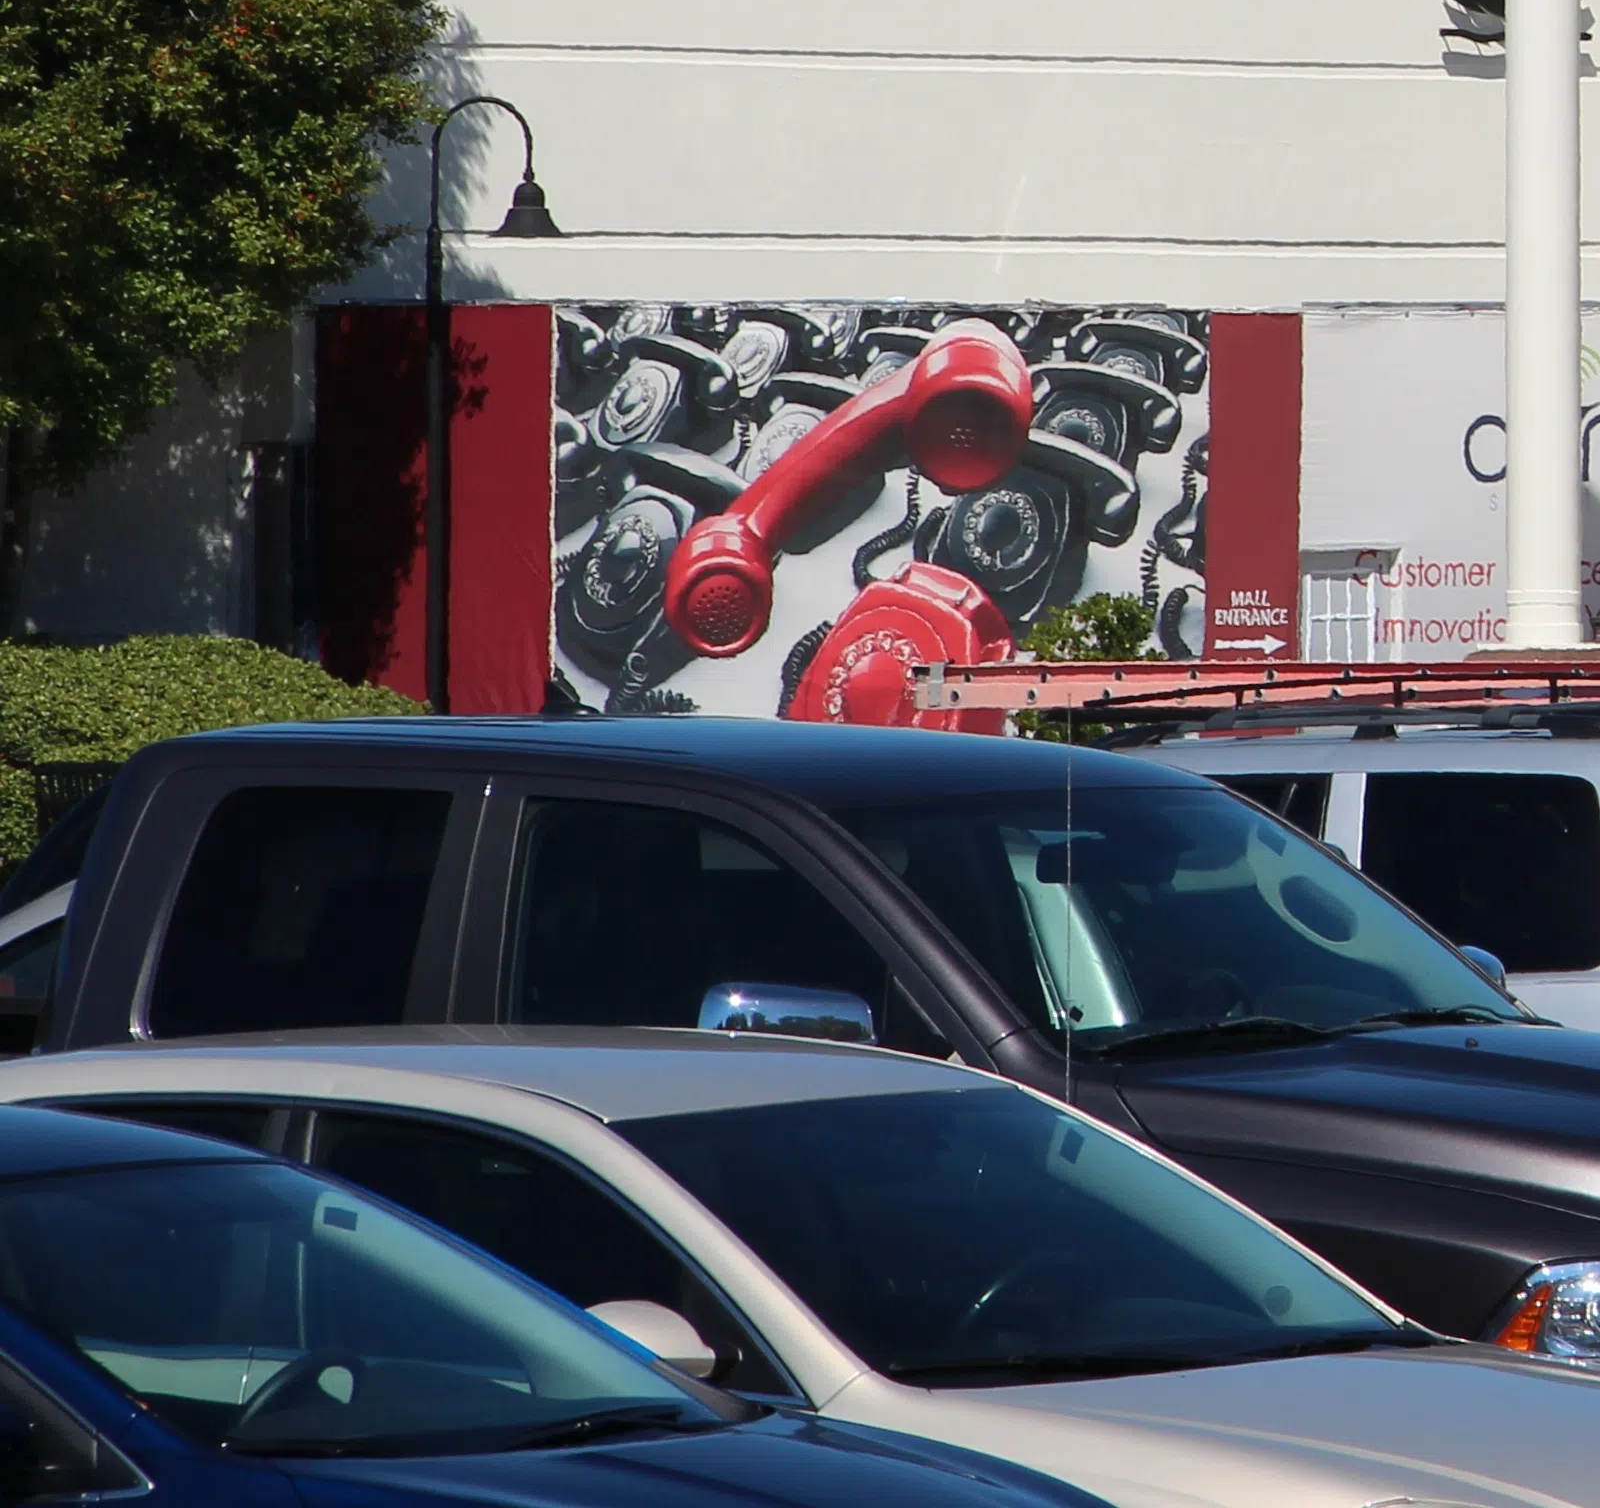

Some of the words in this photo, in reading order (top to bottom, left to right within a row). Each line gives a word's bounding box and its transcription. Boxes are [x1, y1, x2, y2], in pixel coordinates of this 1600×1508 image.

[1352, 548, 1497, 588] Customer
[1230, 589, 1271, 607] MALL
[1214, 607, 1289, 627] ENTRANCE
